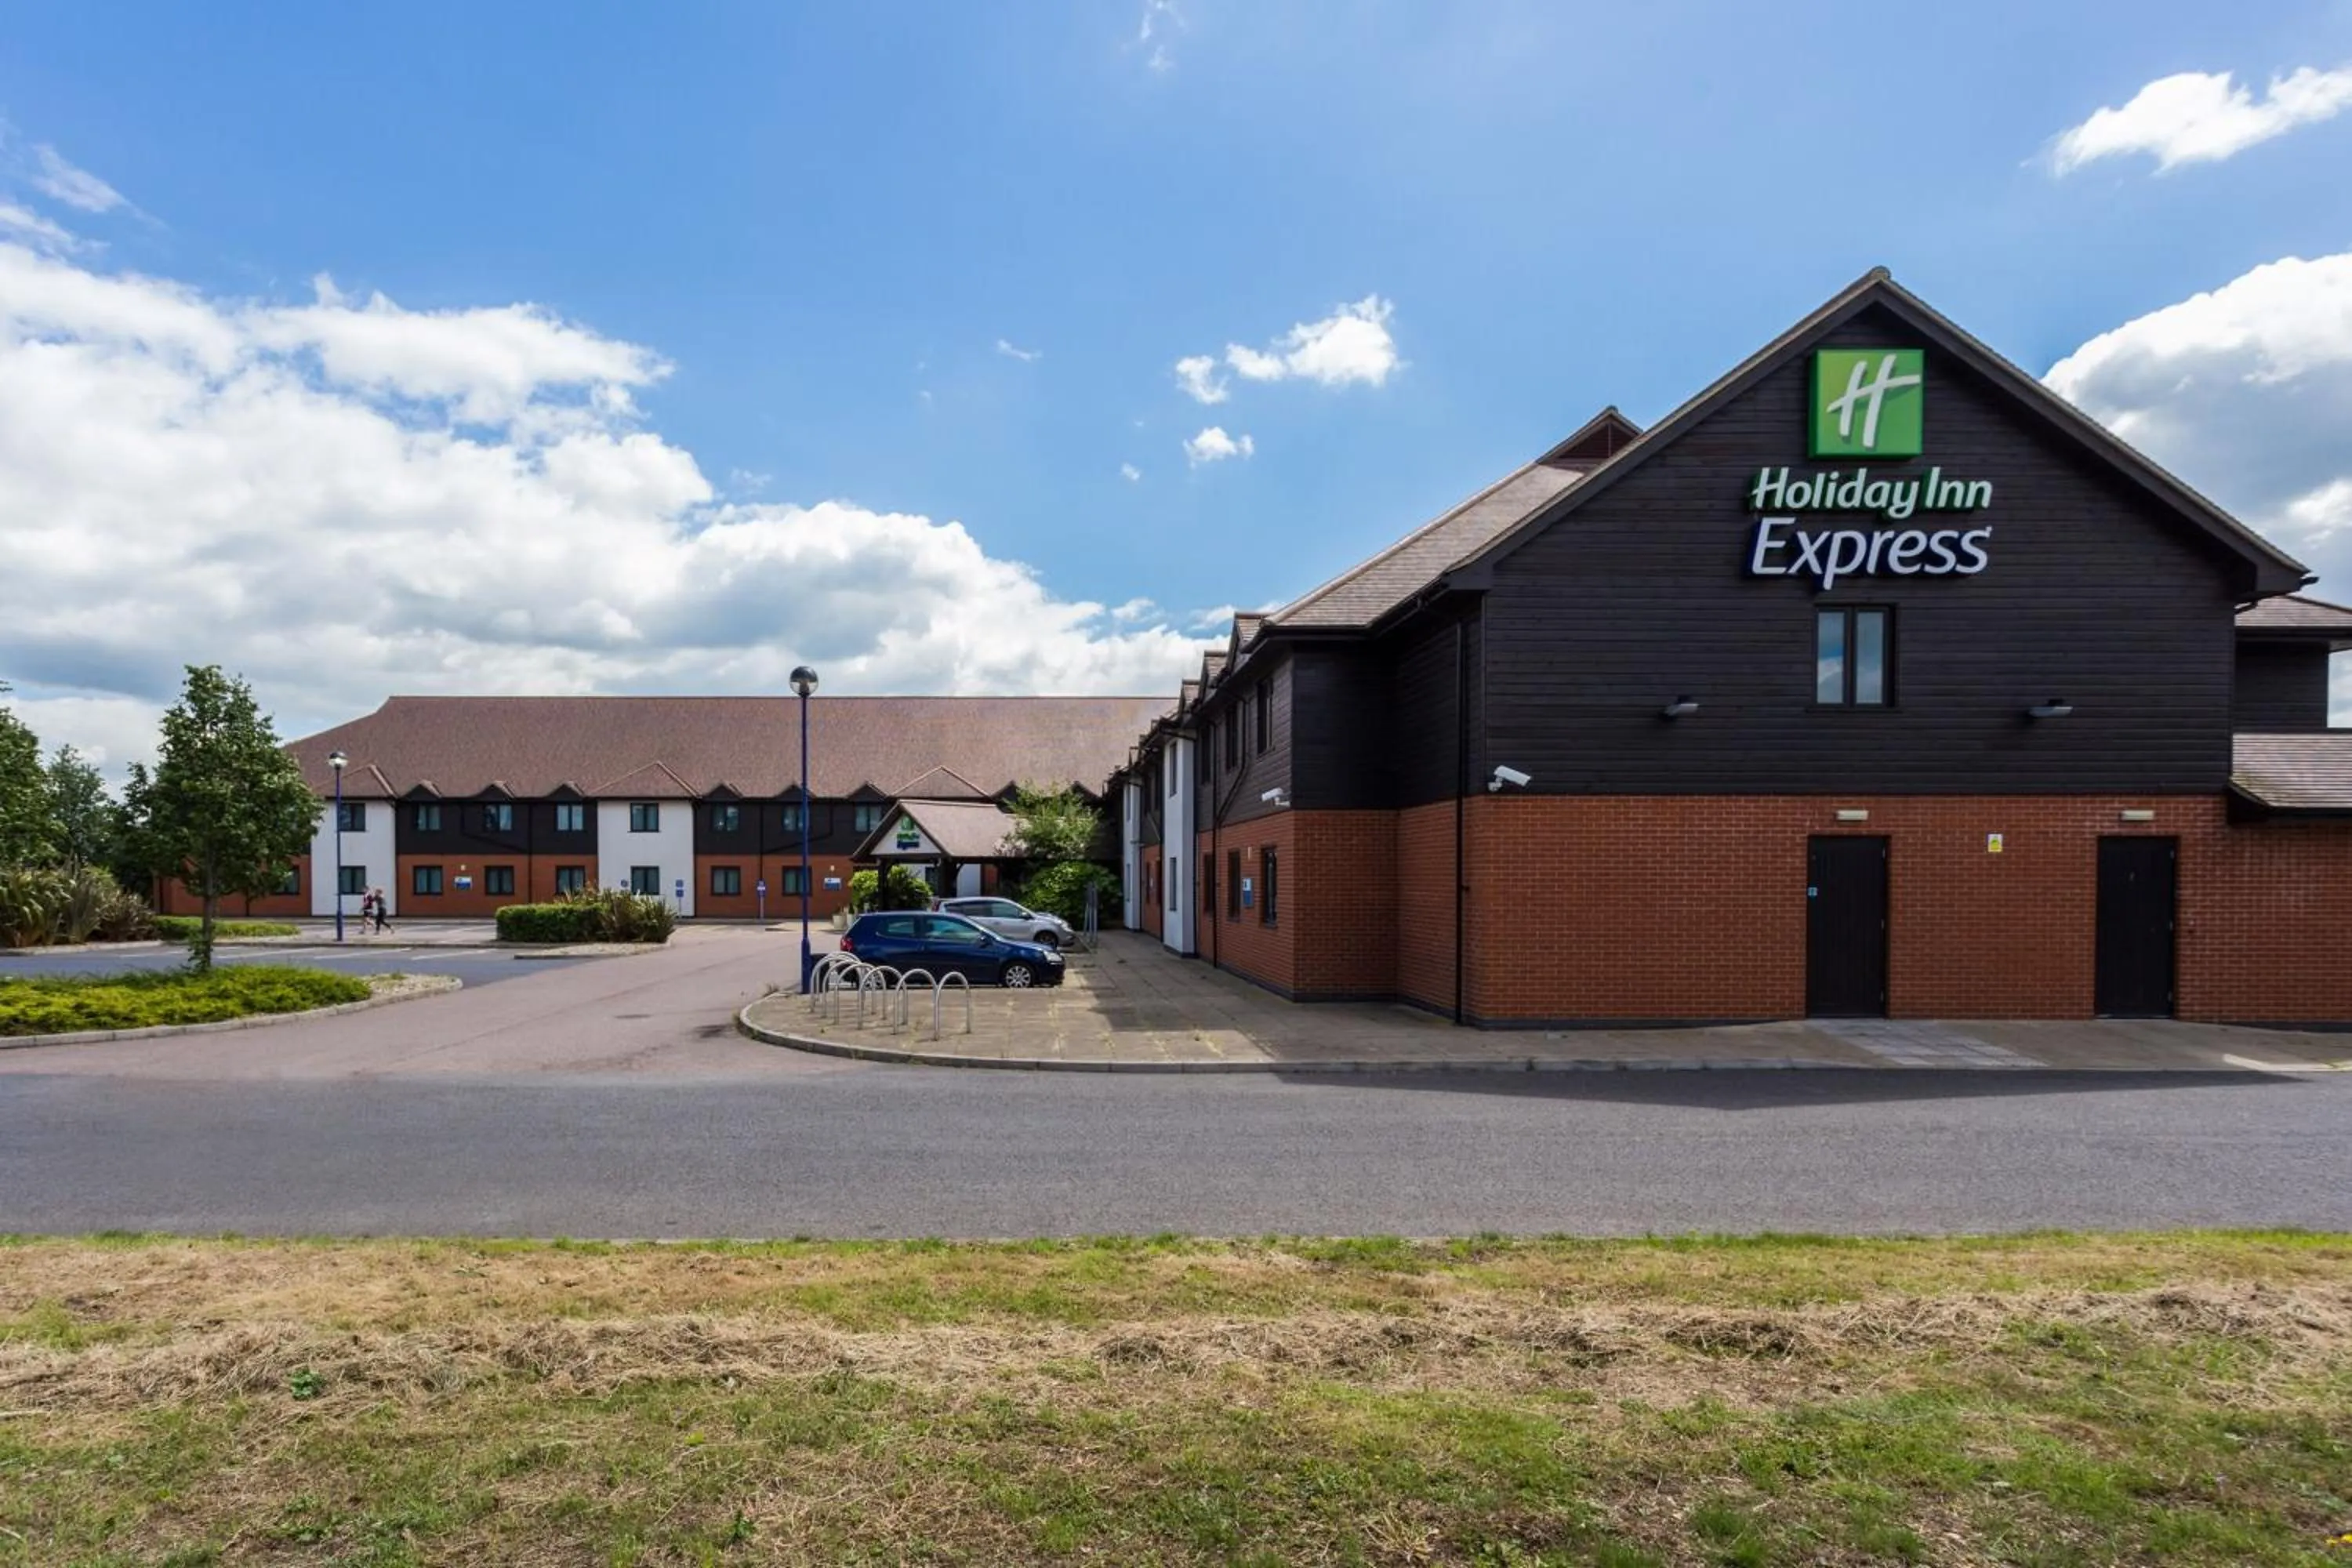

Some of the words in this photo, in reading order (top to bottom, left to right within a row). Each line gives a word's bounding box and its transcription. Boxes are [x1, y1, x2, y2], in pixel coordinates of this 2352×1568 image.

[1826, 354, 1921, 448] H
[1751, 466, 1919, 519] Holiday
[1925, 466, 1993, 508] Inn
[1751, 517, 1991, 590] Express
